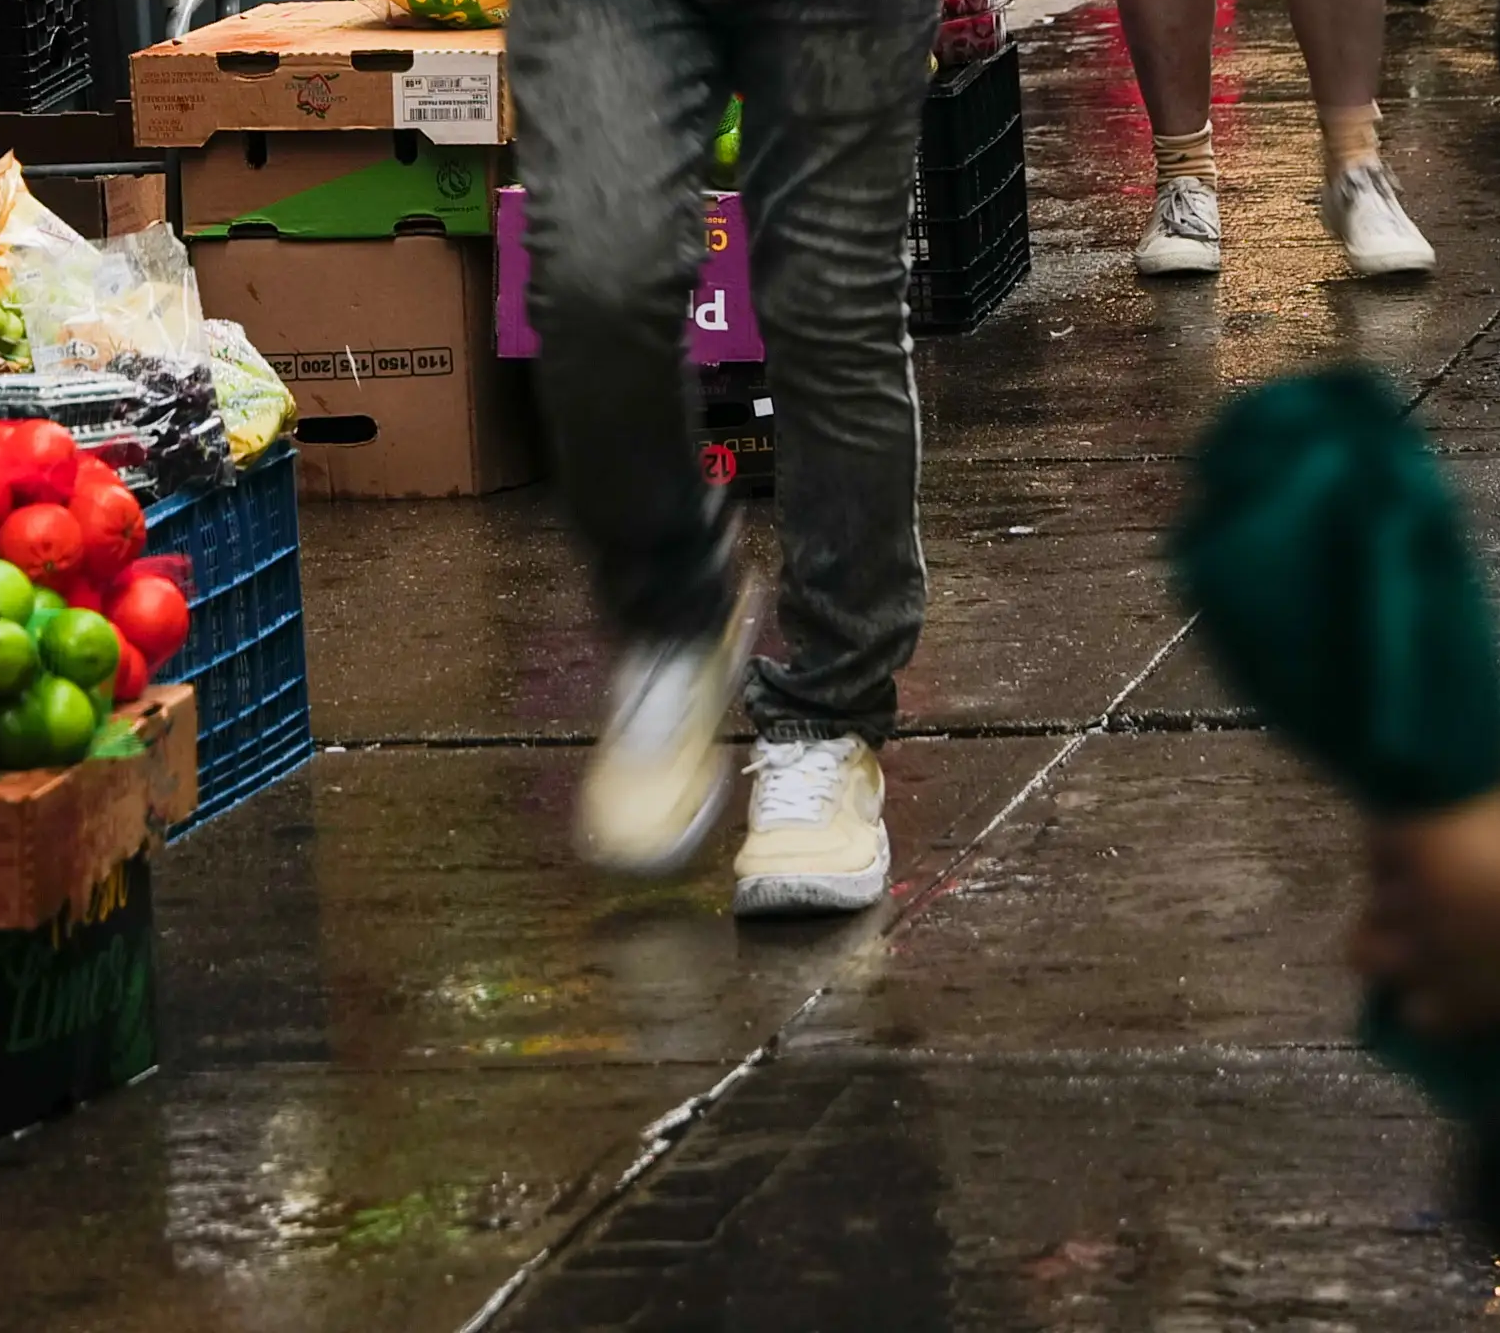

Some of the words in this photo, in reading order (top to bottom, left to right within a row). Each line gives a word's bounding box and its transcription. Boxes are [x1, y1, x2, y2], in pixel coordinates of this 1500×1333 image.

[301, 359, 332, 374] 200
[378, 357, 409, 371] 150
[417, 354, 448, 370] 110
[704, 452, 732, 479] 12
